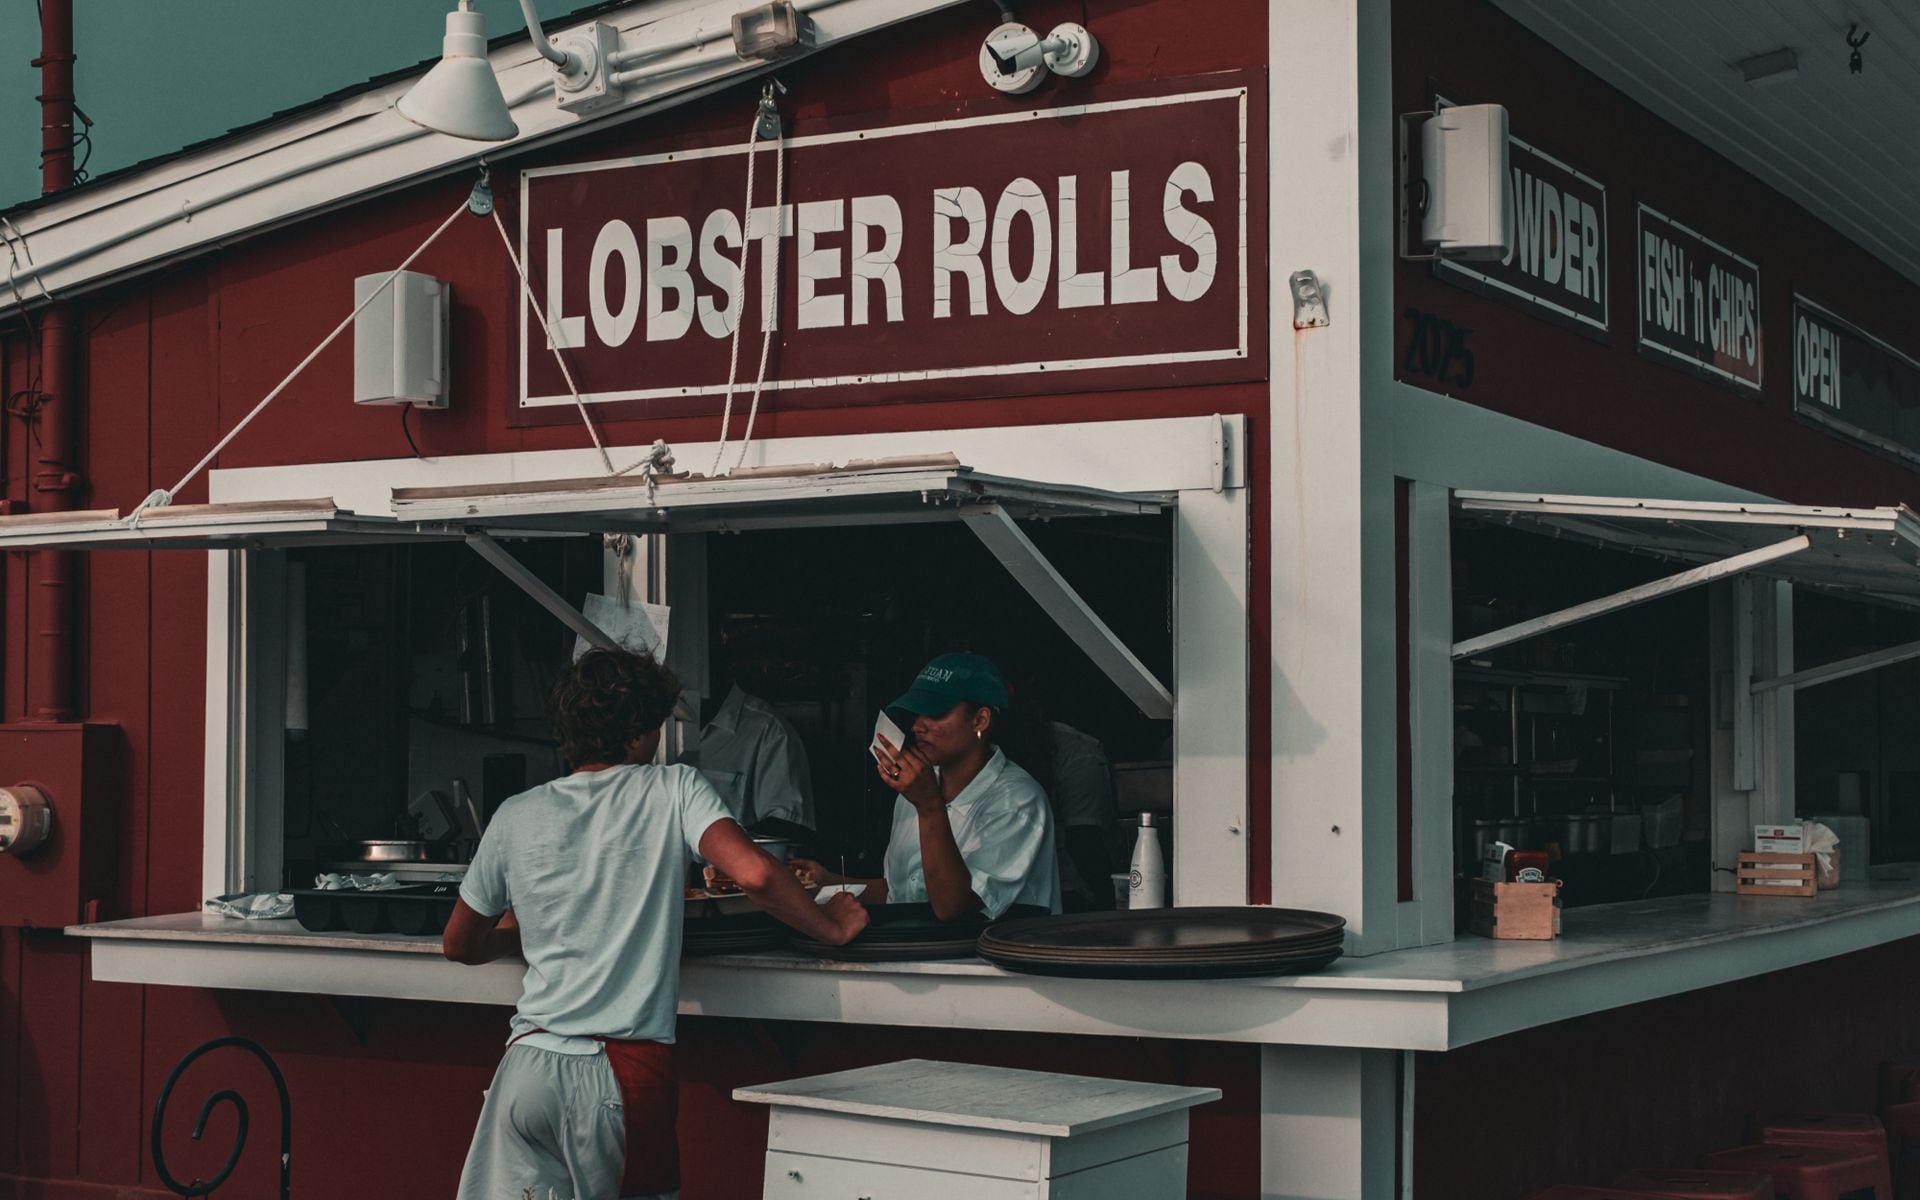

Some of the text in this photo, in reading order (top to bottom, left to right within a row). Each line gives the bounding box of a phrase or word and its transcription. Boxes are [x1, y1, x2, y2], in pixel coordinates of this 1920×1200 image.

[546, 161, 1217, 350] LOBSTER ROLLS
[1501, 167, 1600, 304] WDER
[1645, 230, 1685, 336] FISH
[1708, 263, 1756, 367] CHIPS
[1797, 315, 1841, 410] OPEN
